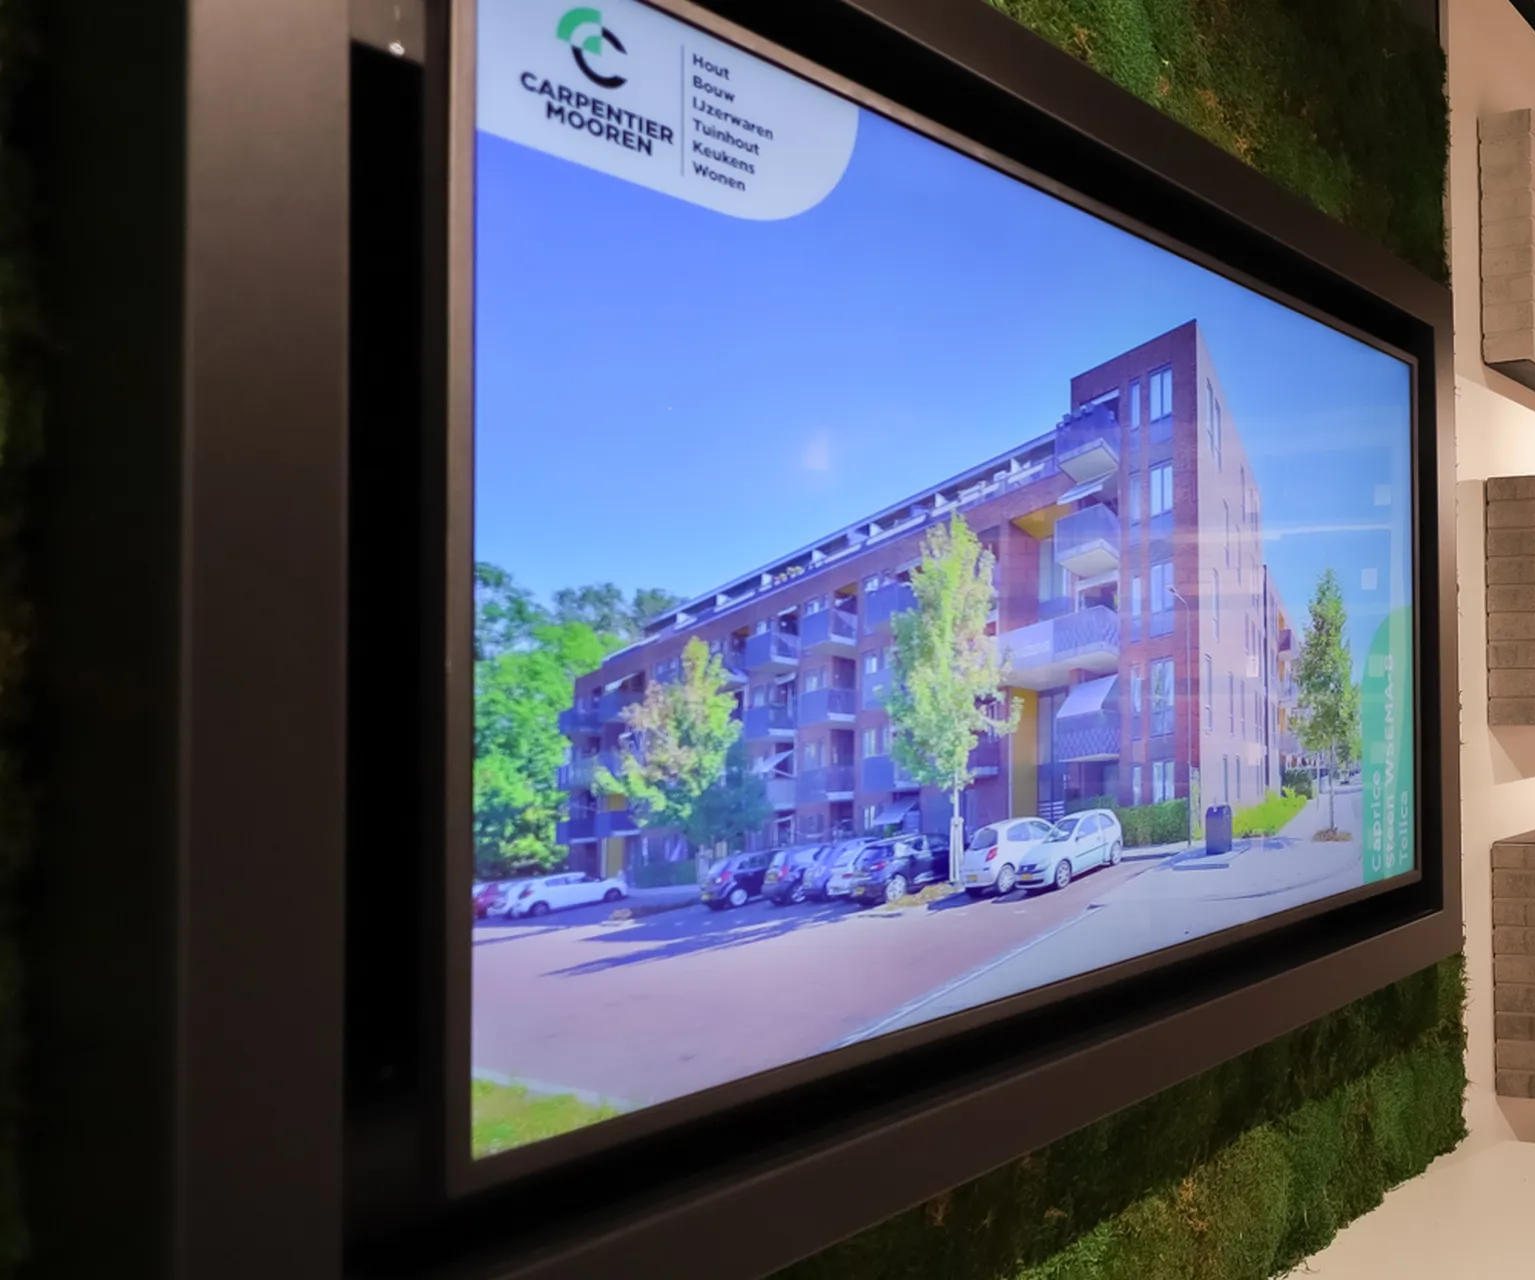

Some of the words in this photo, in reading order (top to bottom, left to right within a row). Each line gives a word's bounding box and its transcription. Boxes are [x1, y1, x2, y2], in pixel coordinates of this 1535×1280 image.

[692, 53, 731, 82] Hout
[520, 71, 675, 145] CARPENTIER
[692, 76, 736, 104] Bouw
[546, 101, 654, 157] MOOREN
[692, 97, 775, 141] IJzerwaren
[692, 119, 761, 157] Tuinhout
[692, 141, 757, 176] Keukens
[692, 162, 747, 193] Wonen
[1371, 770, 1382, 873] Caprice
